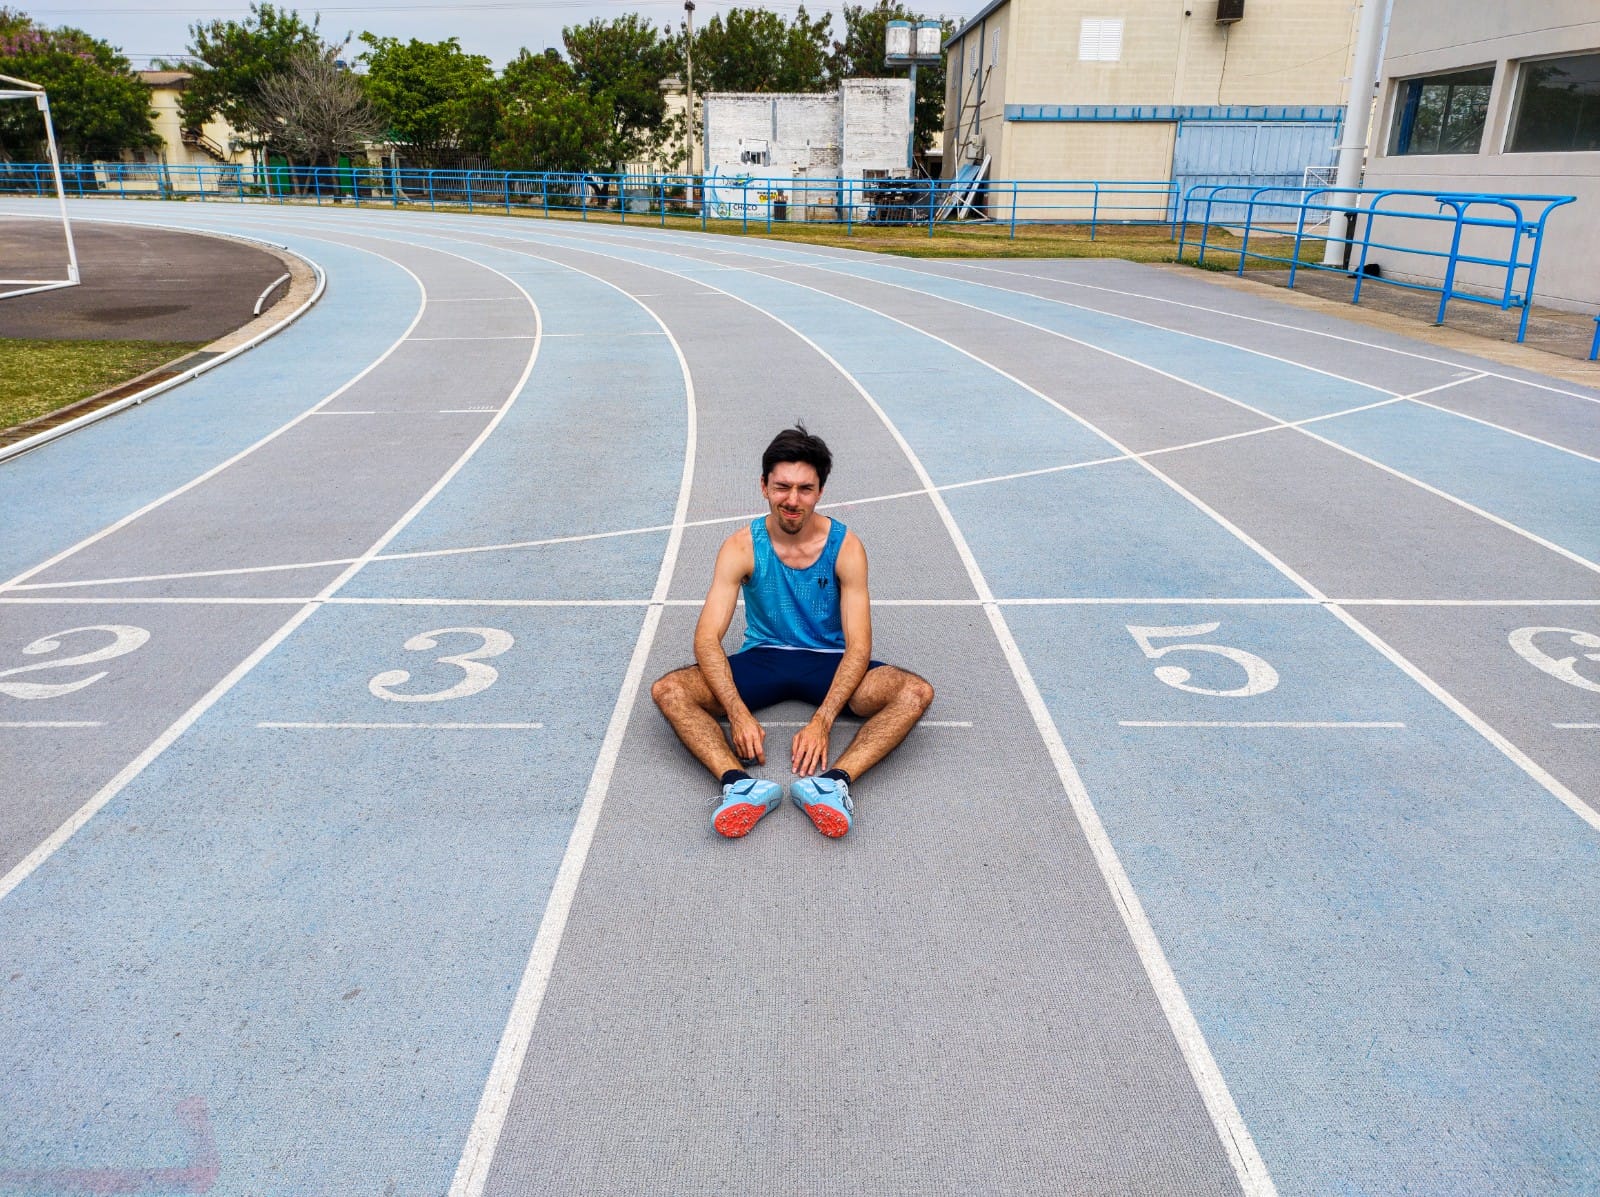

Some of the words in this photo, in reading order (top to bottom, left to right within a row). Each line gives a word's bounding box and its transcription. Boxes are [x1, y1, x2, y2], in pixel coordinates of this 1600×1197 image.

[0, 625, 150, 699] 2
[368, 627, 515, 702] 3
[1125, 622, 1279, 697] 5
[1508, 627, 1600, 693] 6
